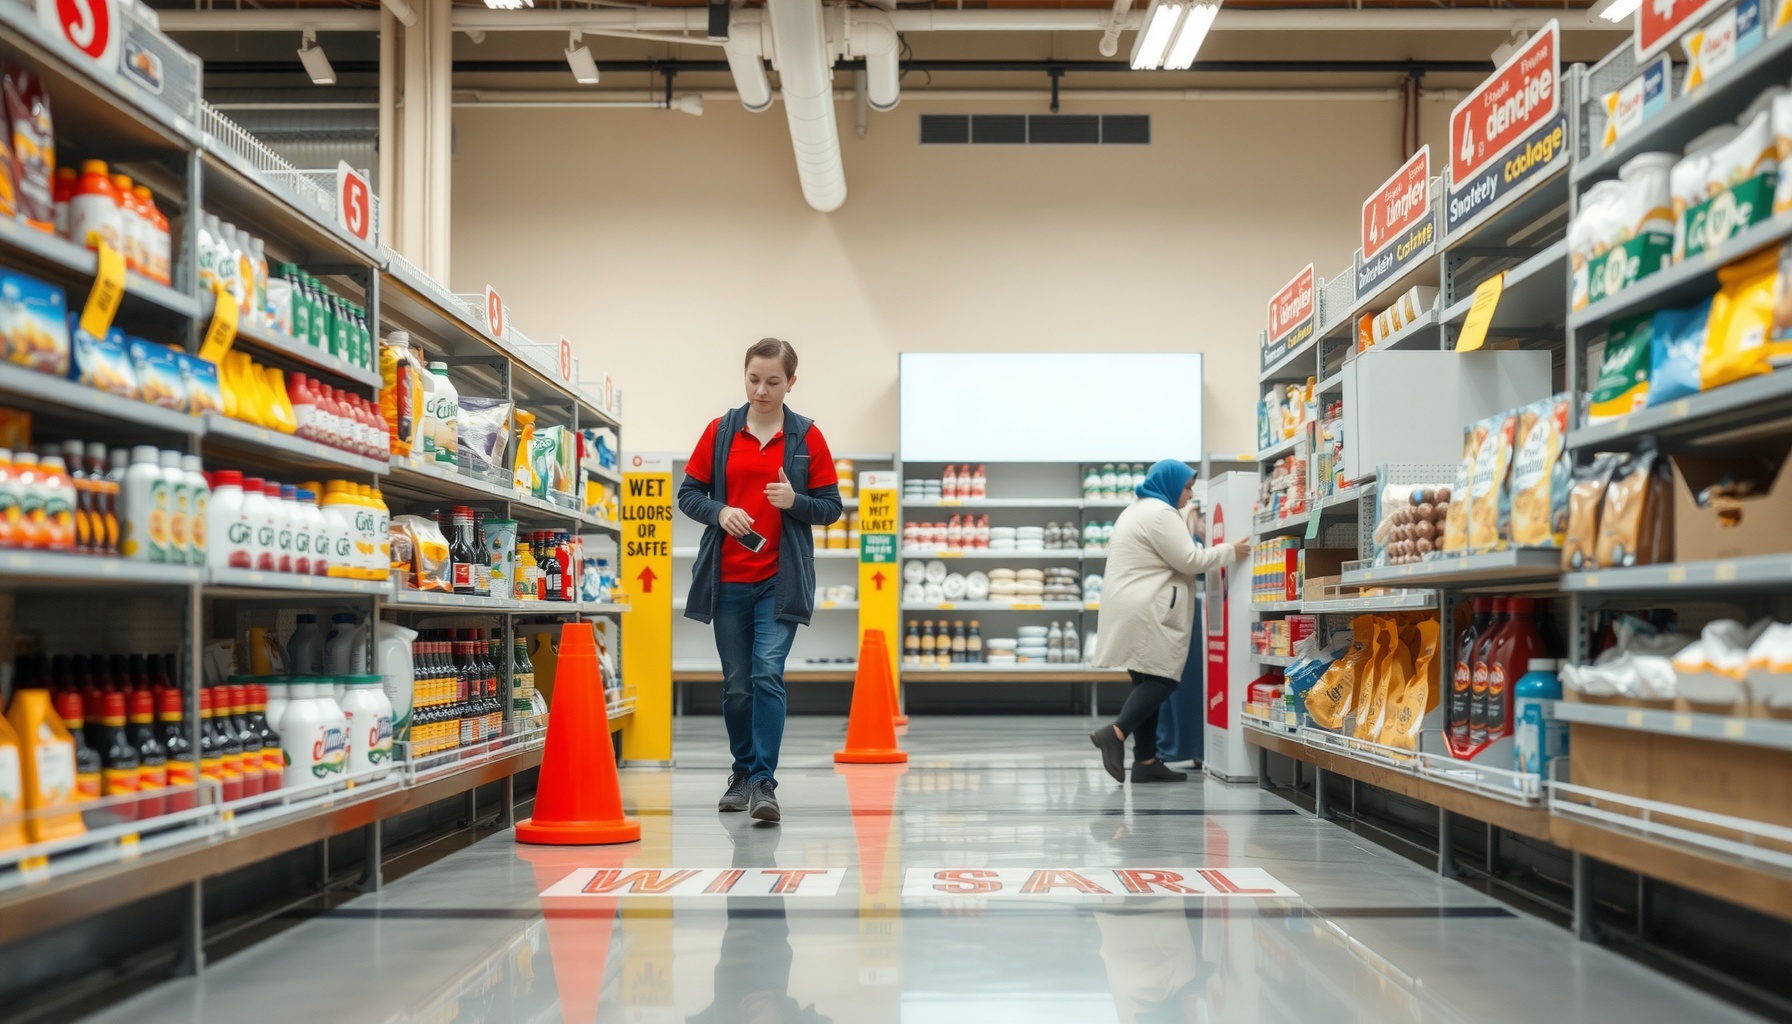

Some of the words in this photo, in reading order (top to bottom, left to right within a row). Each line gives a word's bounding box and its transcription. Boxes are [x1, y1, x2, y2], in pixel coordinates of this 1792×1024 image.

[1461, 111, 1474, 166] 4
[350, 184, 362, 233] 5
[629, 479, 665, 497] WET
[622, 505, 673, 521] LLOORS
[627, 541, 668, 557] SAFTE
[581, 869, 829, 894] WIT
[932, 869, 1277, 894] SARL
